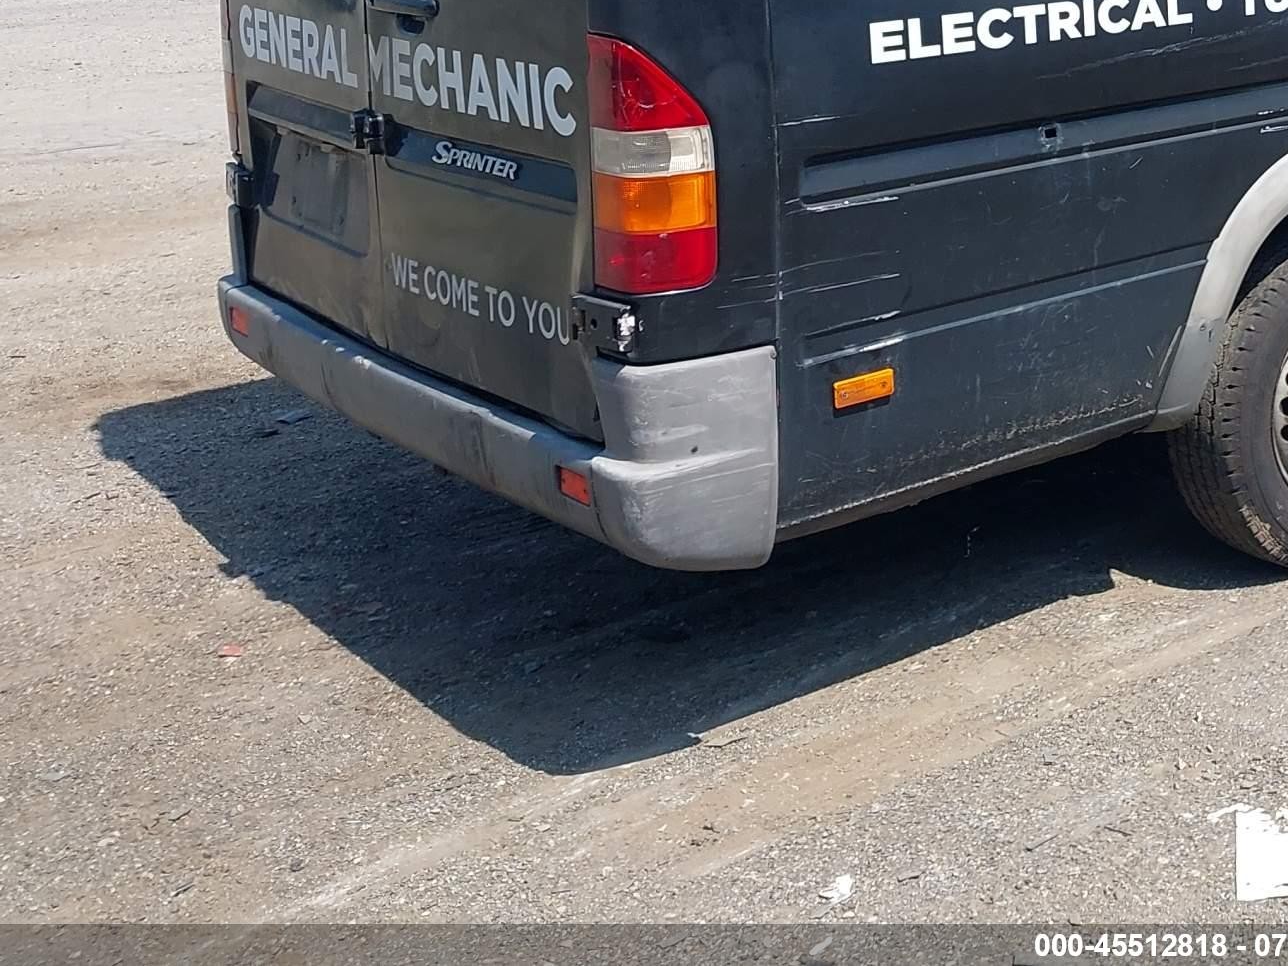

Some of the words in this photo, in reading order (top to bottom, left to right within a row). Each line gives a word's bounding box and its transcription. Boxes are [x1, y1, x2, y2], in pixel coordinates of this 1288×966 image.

[239, 4, 358, 88] GENERAL
[367, 34, 577, 137] MECHANIC
[391, 252, 420, 295] WE
[424, 265, 481, 317] COME
[484, 286, 516, 327] TO
[522, 296, 570, 346] YOU
